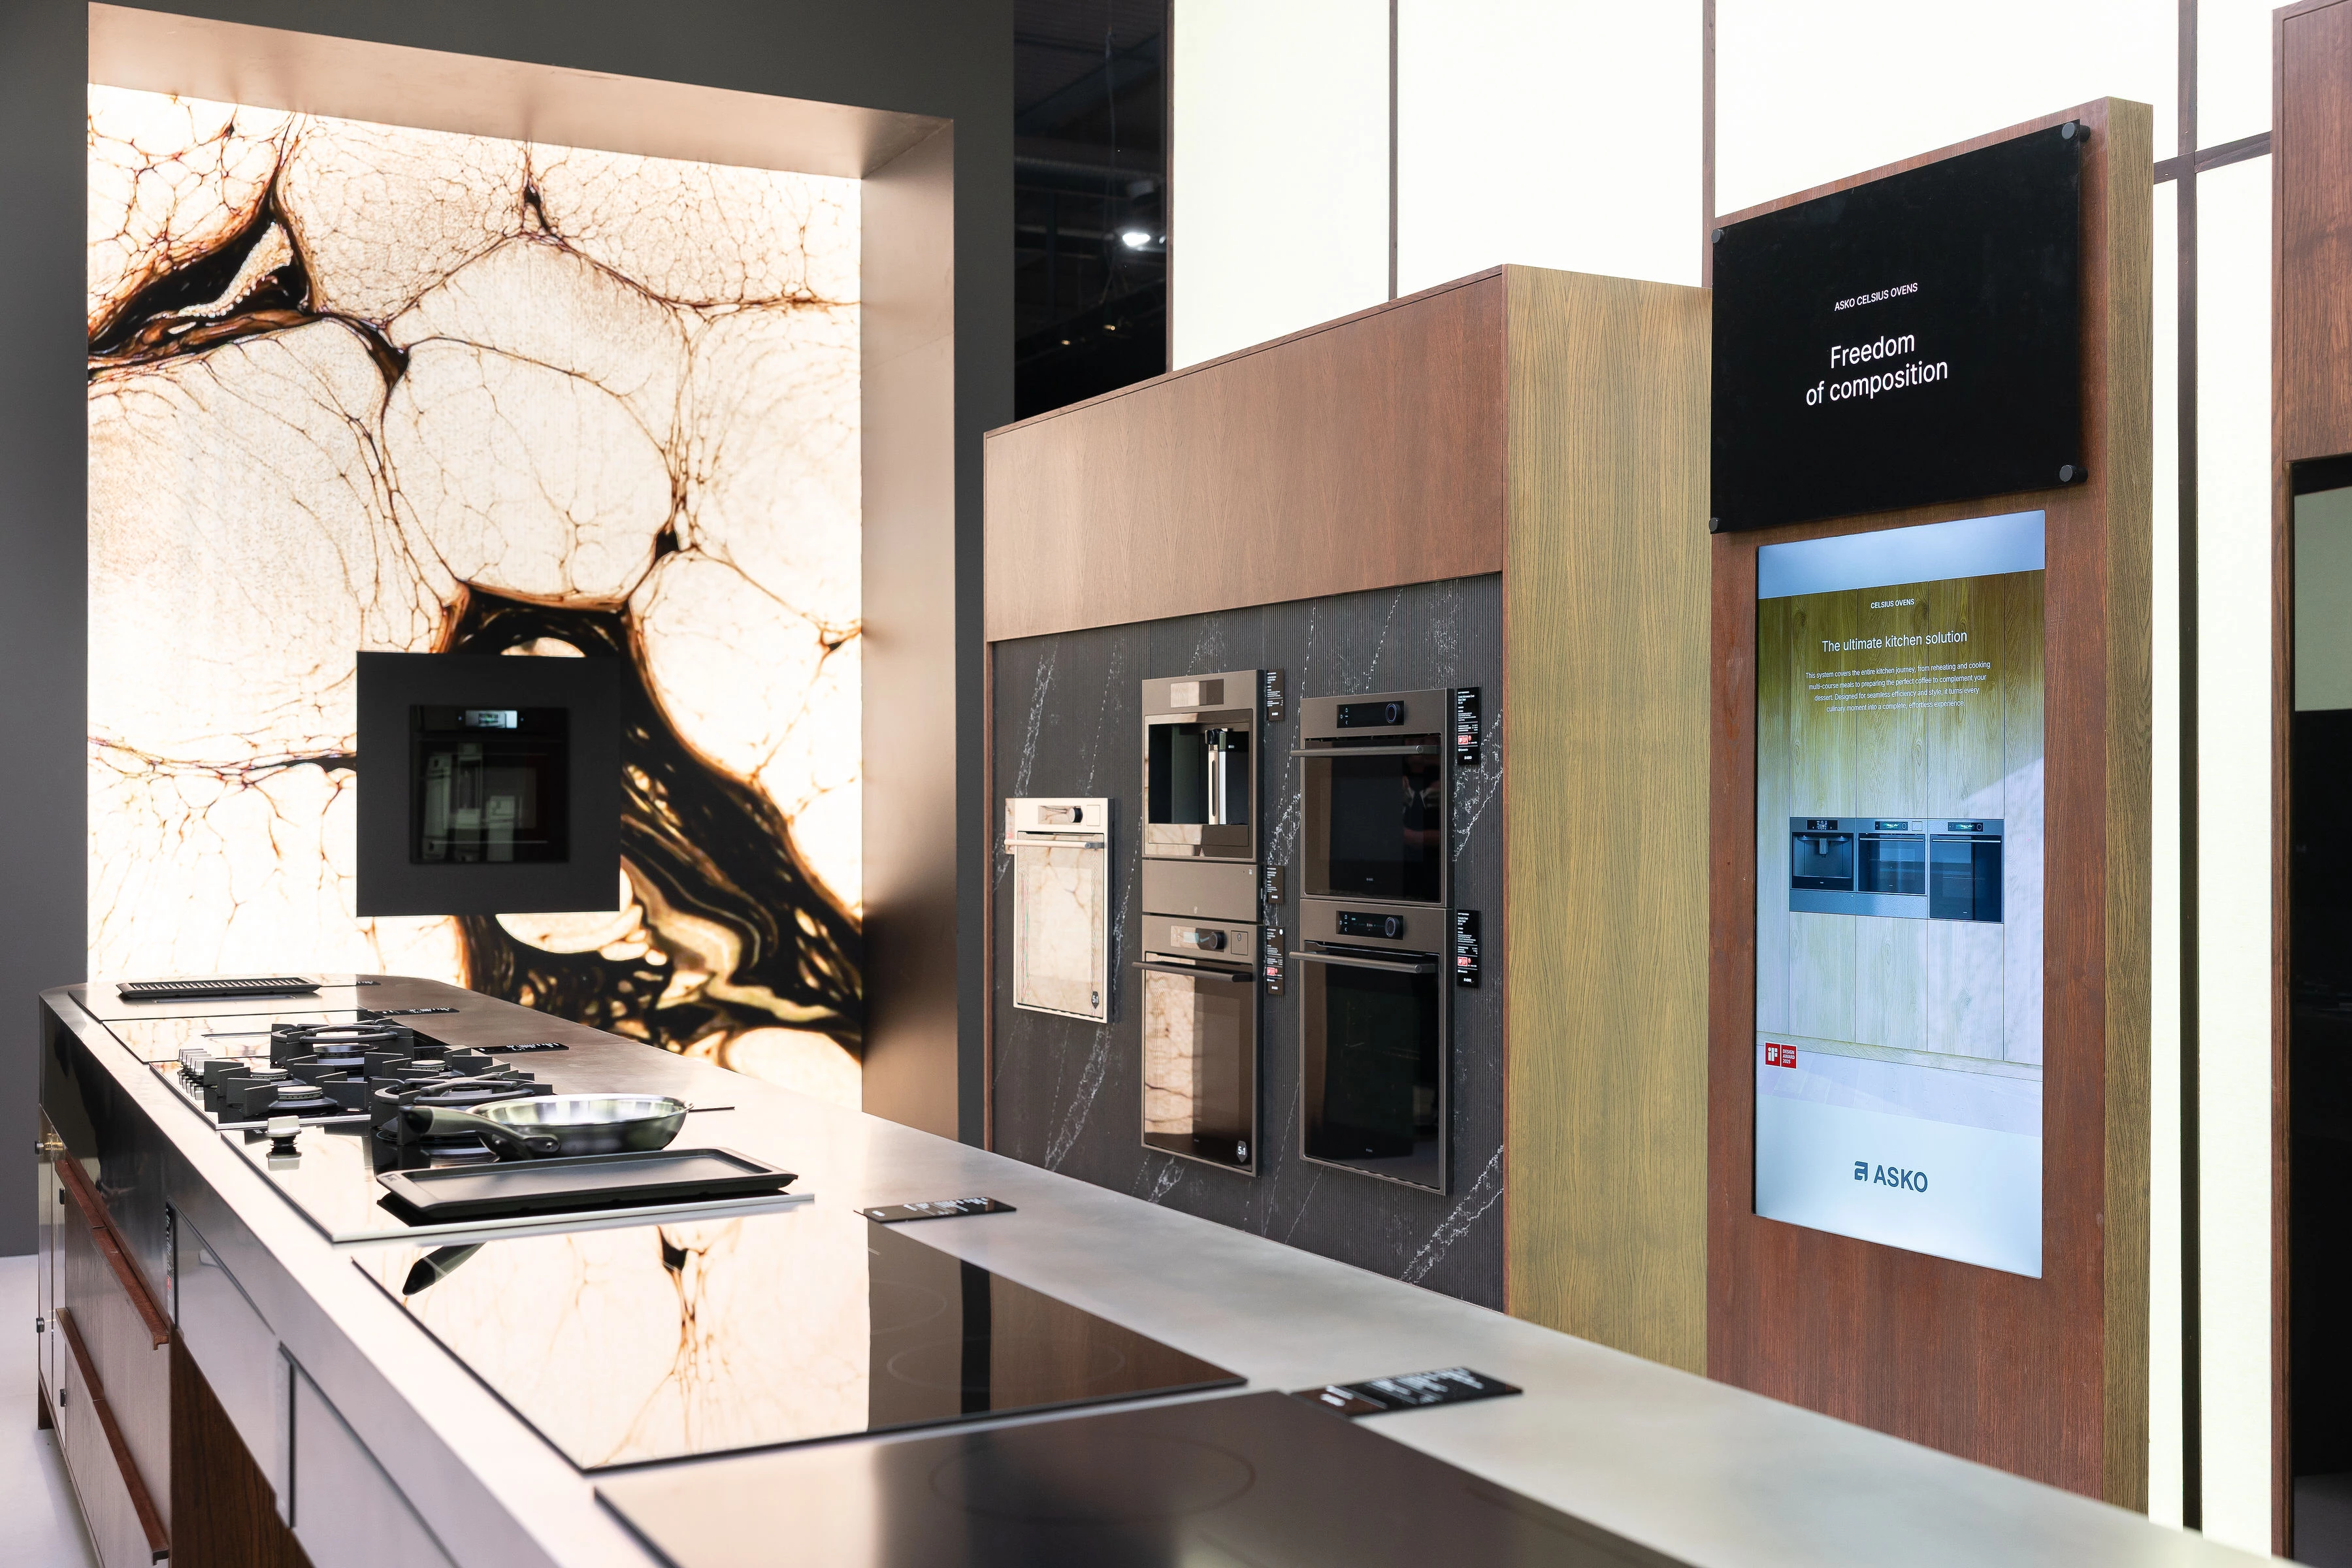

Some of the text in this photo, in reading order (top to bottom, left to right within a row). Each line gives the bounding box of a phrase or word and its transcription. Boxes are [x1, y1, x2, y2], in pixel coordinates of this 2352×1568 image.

[1835, 283, 1918, 311] ASKO CELSIUS OVENS
[1831, 335, 1914, 368] Freedom
[1806, 361, 1948, 406] of composition
[1895, 598, 1915, 607] OVENS
[1822, 630, 1967, 652] The ultimate kitchen solution
[1931, 663, 1955, 672] reheating
[1861, 679, 1885, 689] preparing
[1895, 678, 1914, 687] perfect
[1939, 675, 1972, 683] complement
[1835, 693, 1858, 701] Designed
[1873, 1165, 1928, 1192] ASKO
